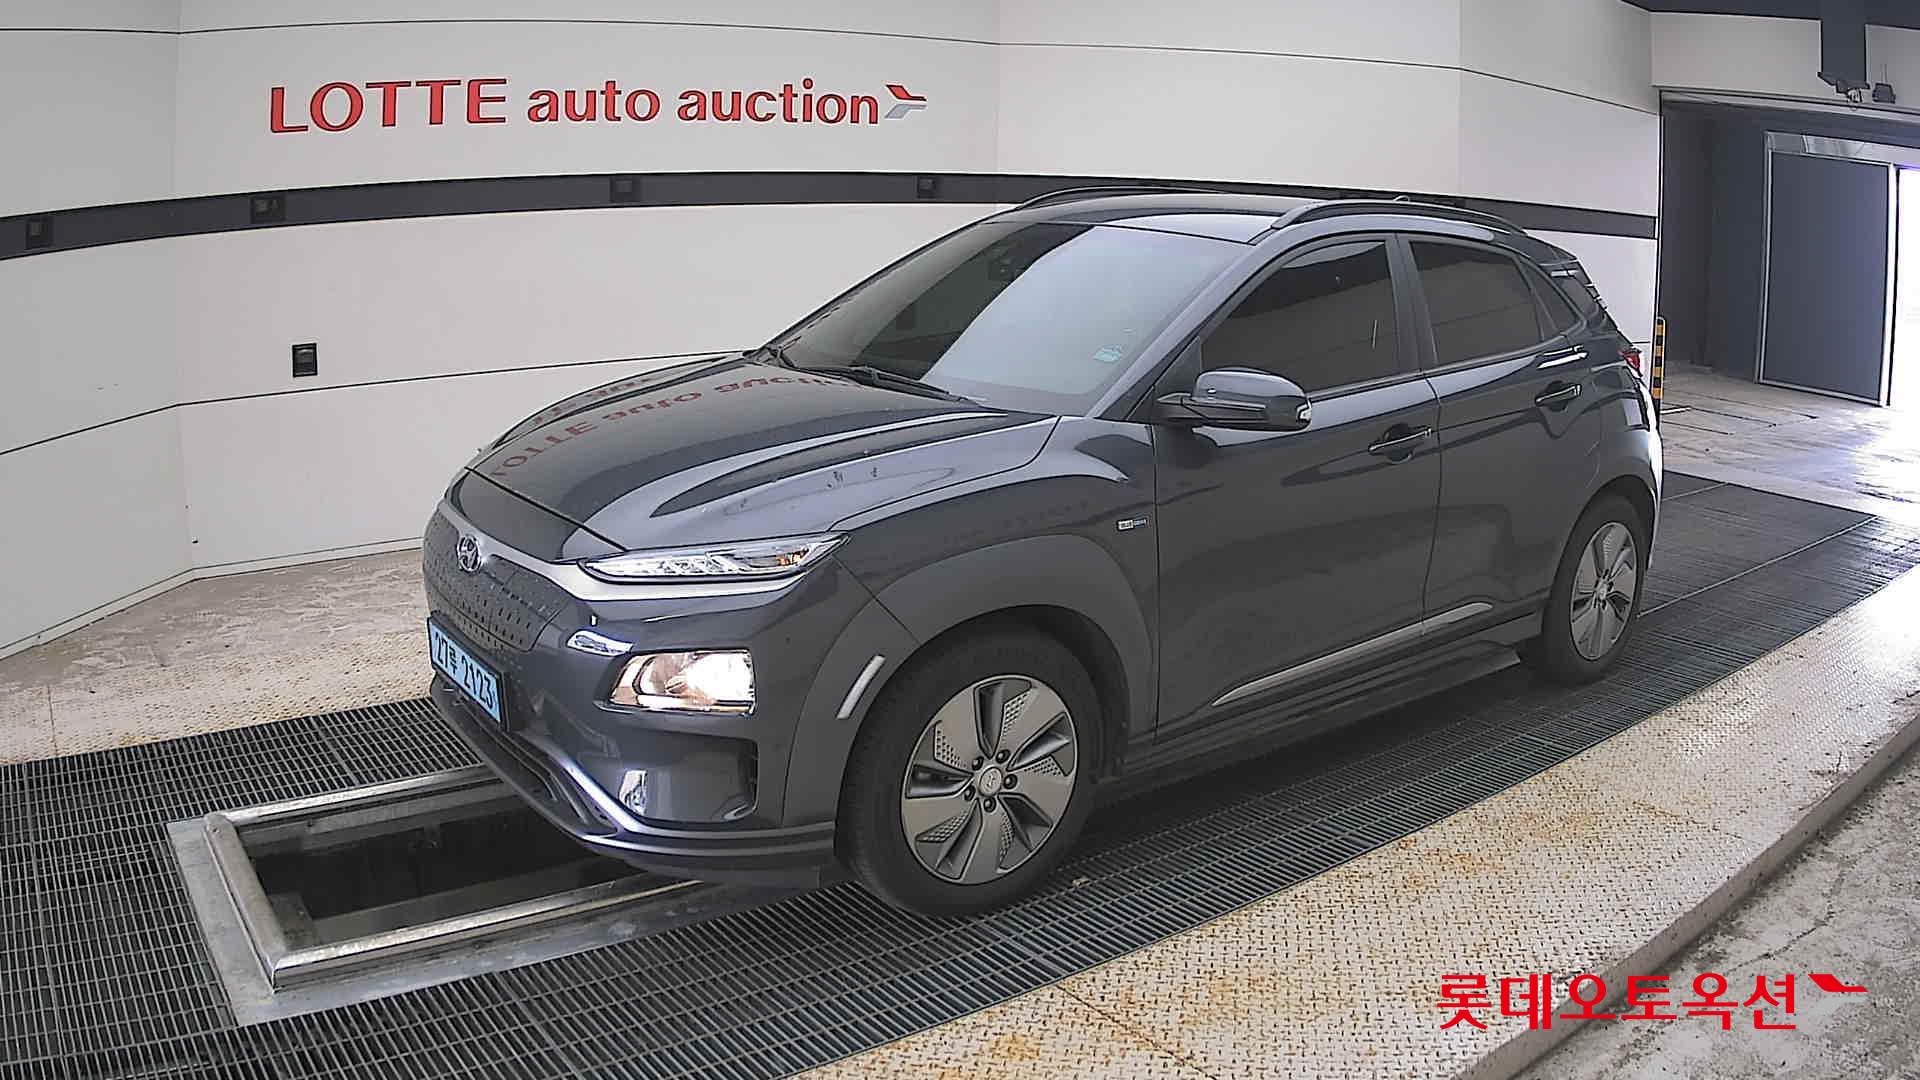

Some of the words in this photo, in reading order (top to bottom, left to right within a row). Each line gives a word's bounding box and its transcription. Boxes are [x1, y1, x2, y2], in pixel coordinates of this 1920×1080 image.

[270, 79, 507, 133] LOTTE
[528, 81, 661, 122] auto
[678, 79, 879, 124] auction
